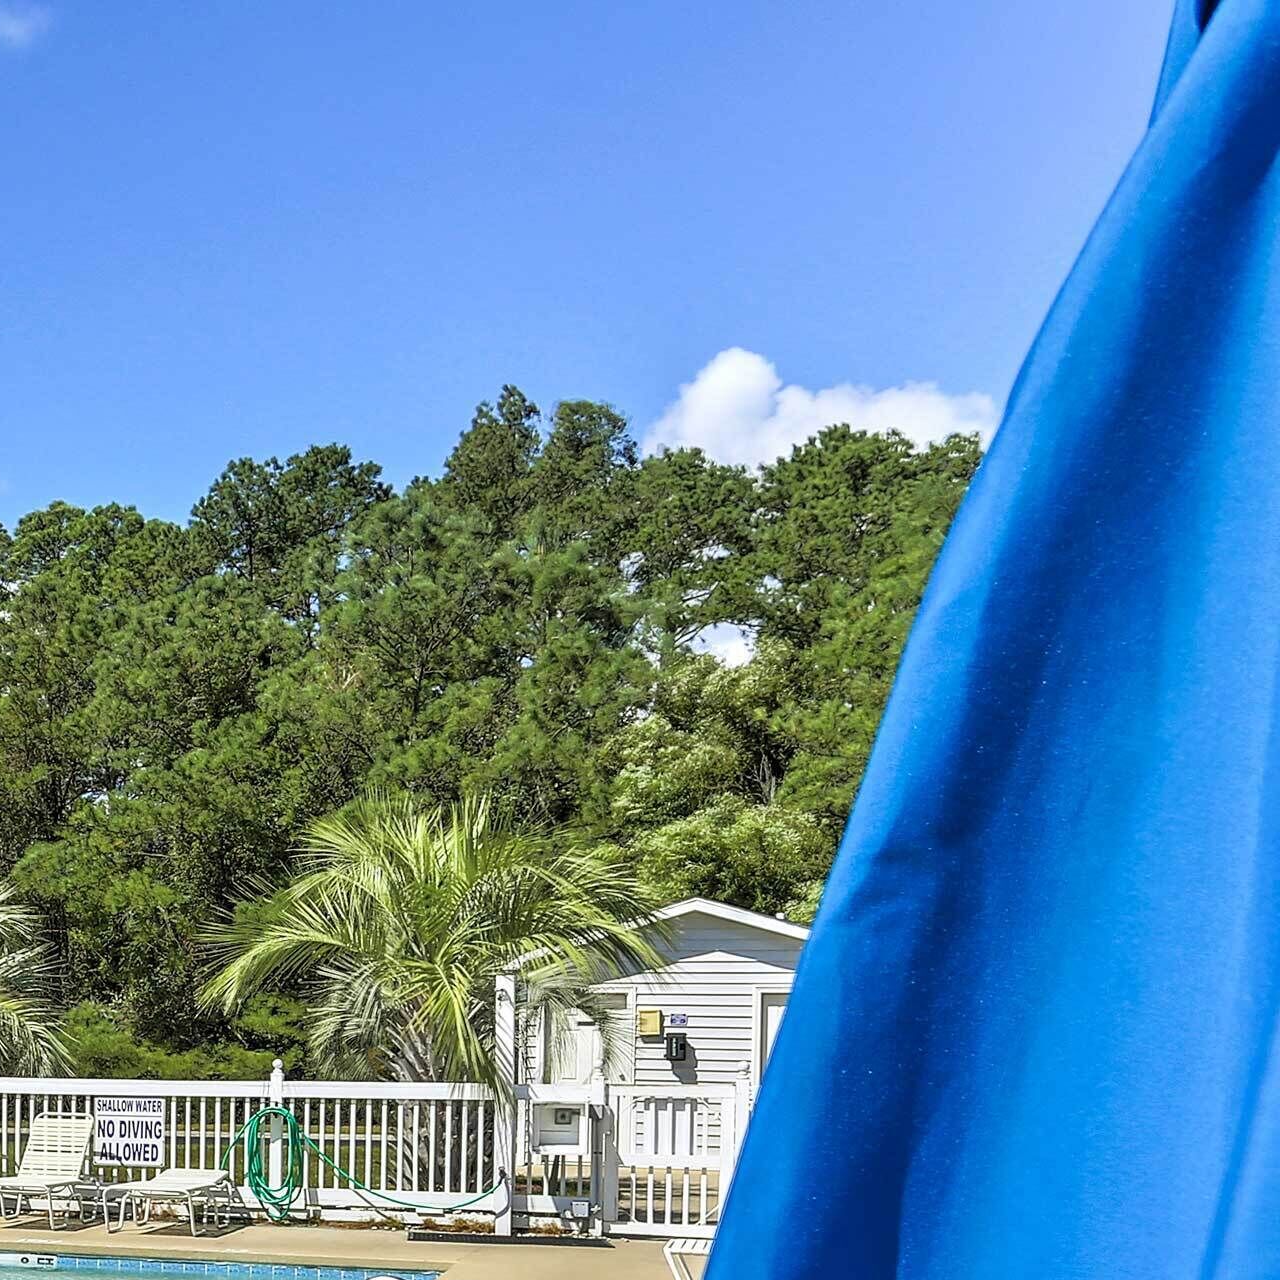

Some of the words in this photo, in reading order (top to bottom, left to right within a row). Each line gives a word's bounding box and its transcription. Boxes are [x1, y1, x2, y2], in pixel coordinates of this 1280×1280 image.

[96, 1099, 134, 1112] SHALLOW
[135, 1100, 162, 1112] WATER
[97, 1120, 115, 1138] NO
[119, 1120, 162, 1139] DIVING
[100, 1142, 159, 1162] ALLOWED
